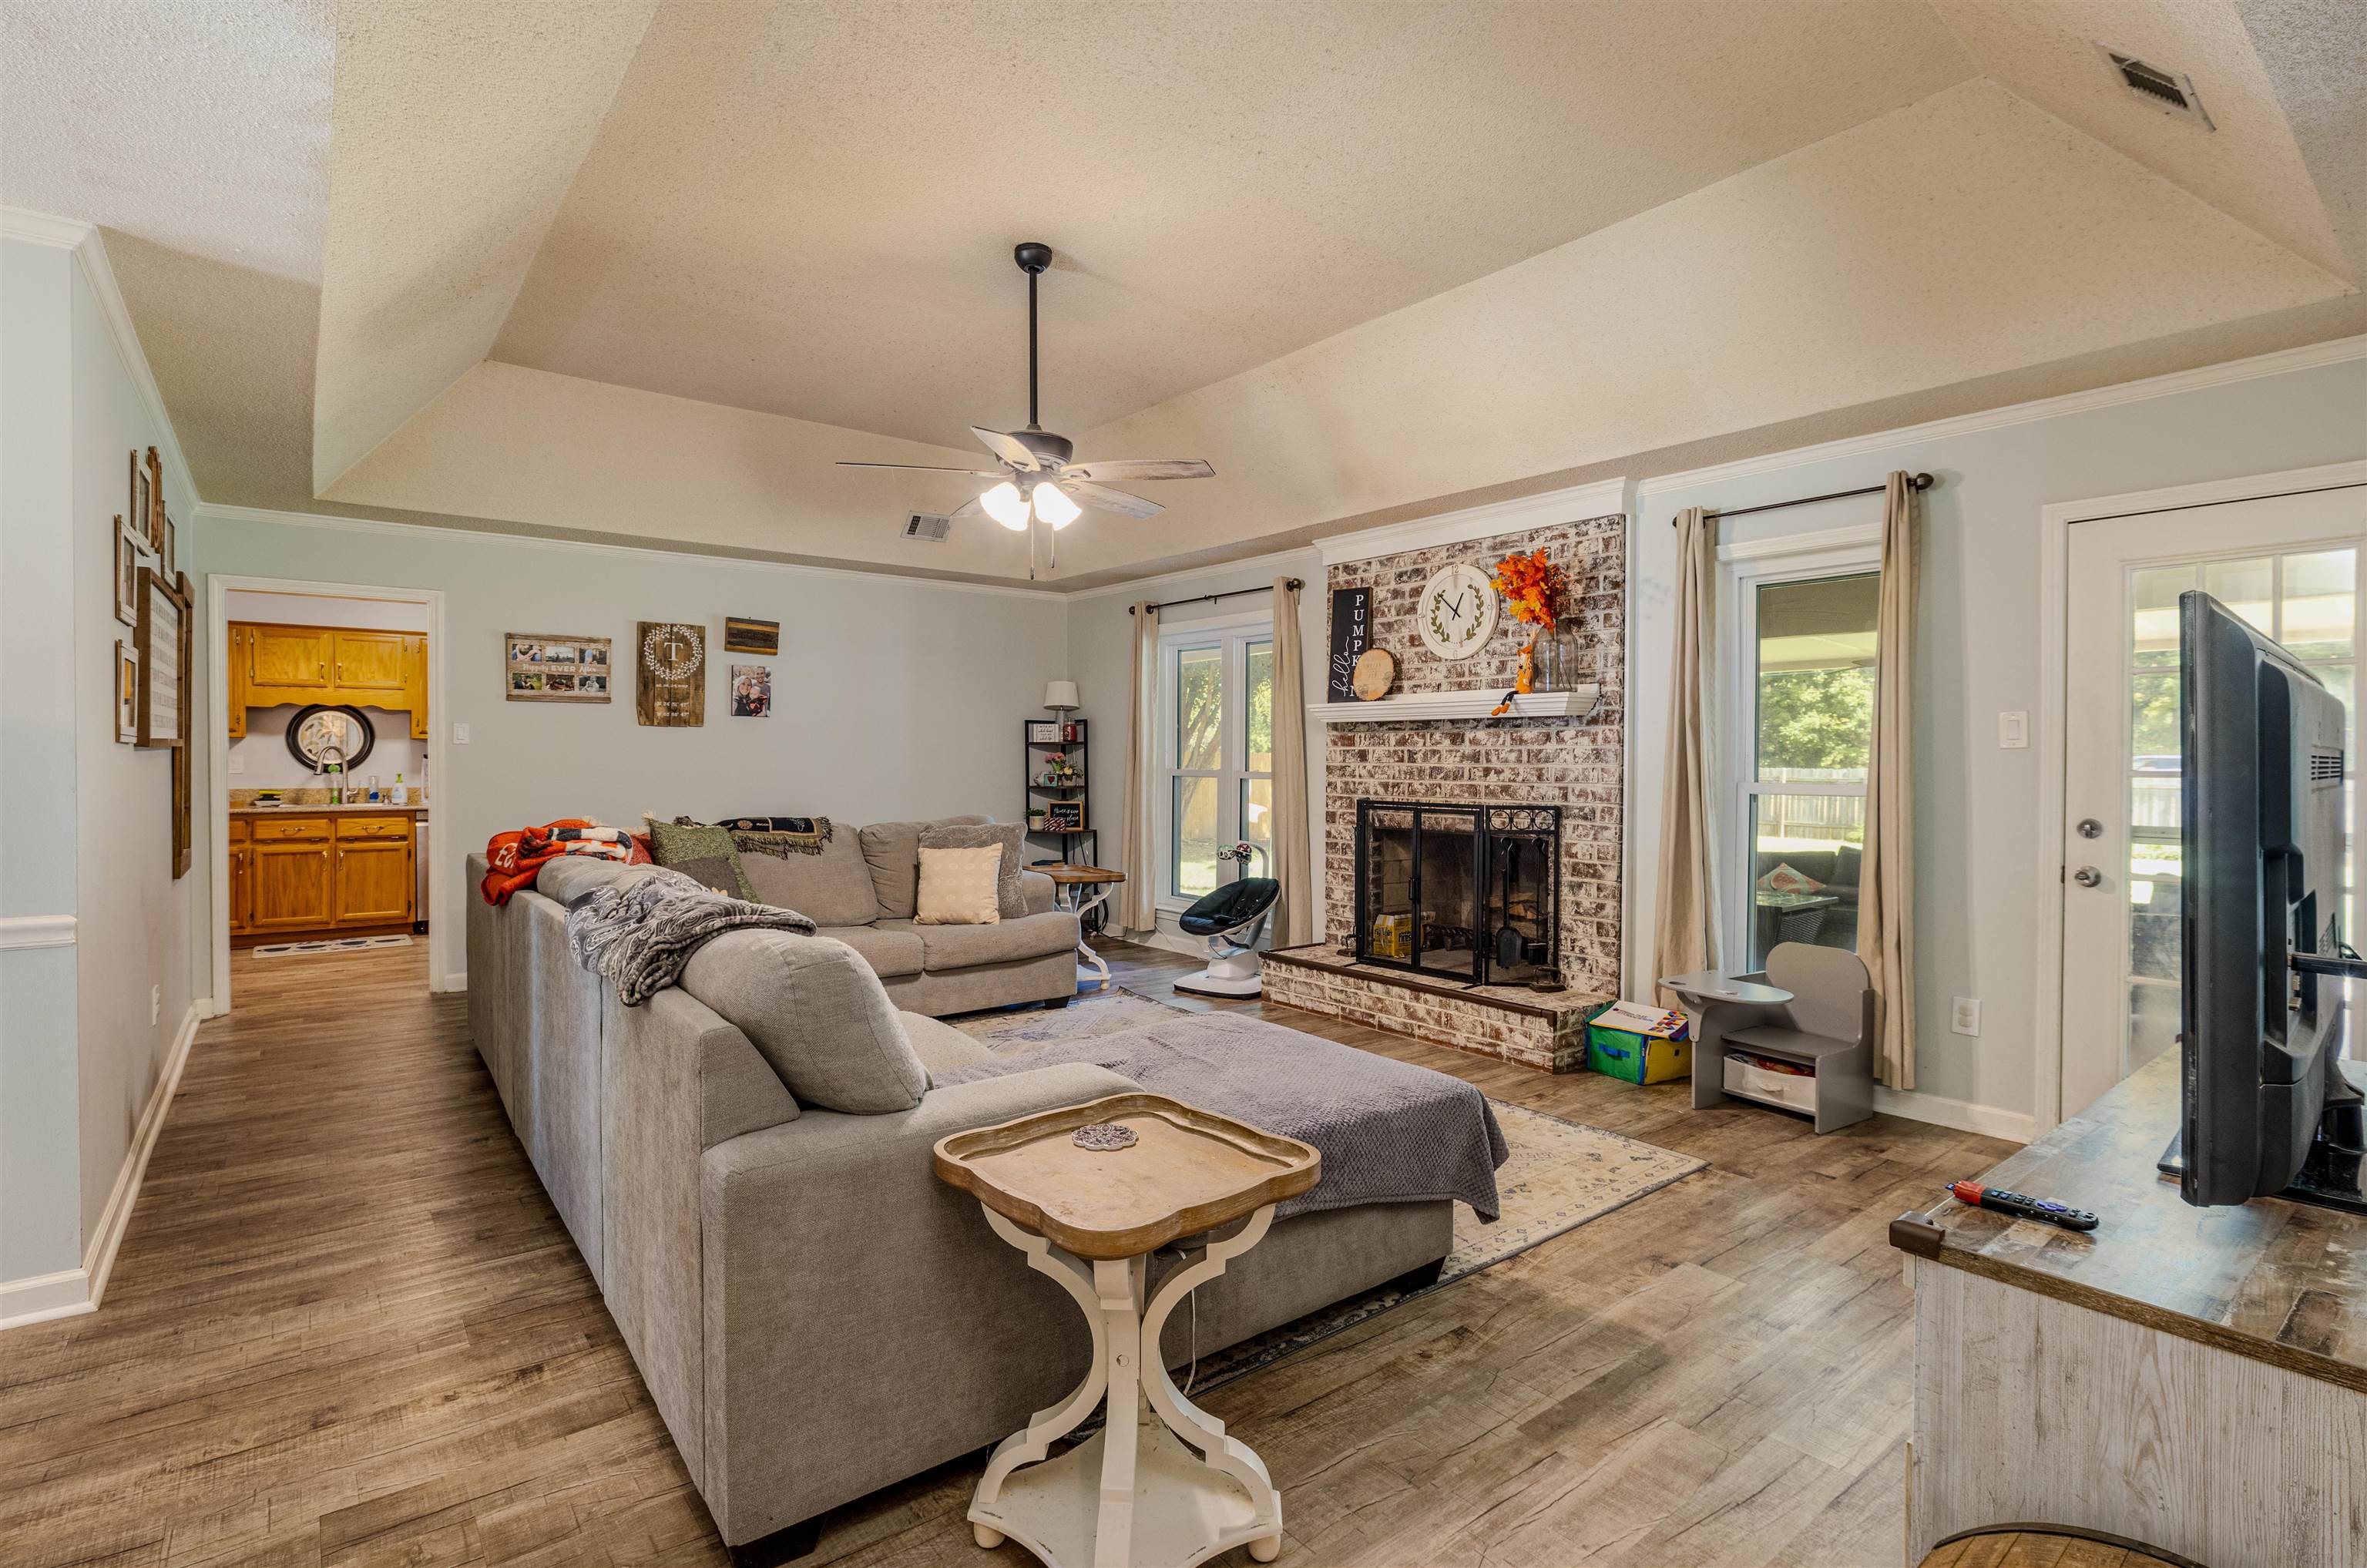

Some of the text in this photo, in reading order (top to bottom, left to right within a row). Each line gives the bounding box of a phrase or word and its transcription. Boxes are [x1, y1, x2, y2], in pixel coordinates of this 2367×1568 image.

[663, 642, 683, 661] T
[1331, 636, 1351, 697] hello
[1349, 594, 1365, 697] PUMPK
